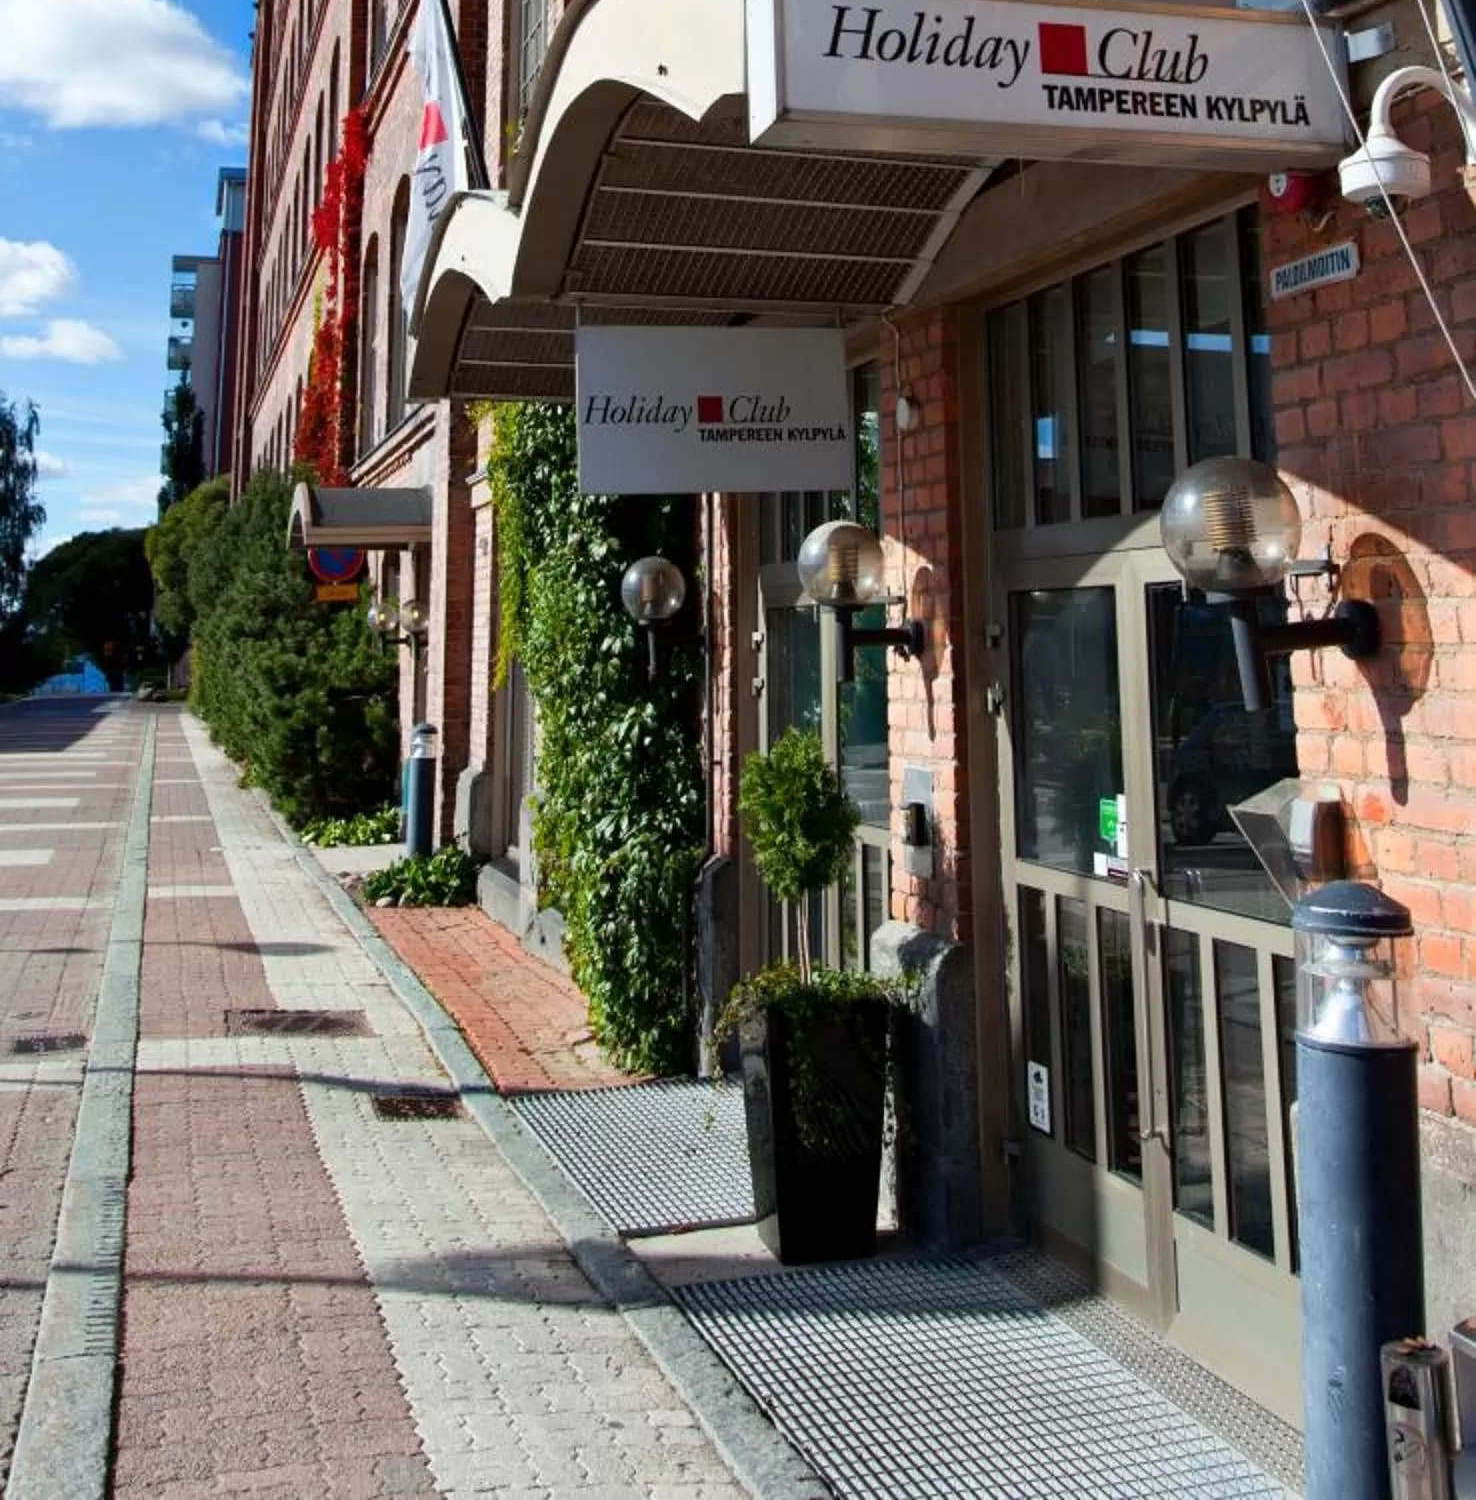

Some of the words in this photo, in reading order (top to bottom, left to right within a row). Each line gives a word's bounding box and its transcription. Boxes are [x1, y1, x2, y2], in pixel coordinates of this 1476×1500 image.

[823, 5, 1030, 88] Holiday
[1098, 27, 1209, 84] Club
[1042, 84, 1198, 118] TAMPEREEN
[1205, 95, 1310, 126] KYLPYLÄ
[583, 395, 692, 432] Holiday
[729, 395, 791, 423] Club
[698, 427, 783, 442] TAMPEREEN
[787, 424, 846, 441] KYLPYLÄ
